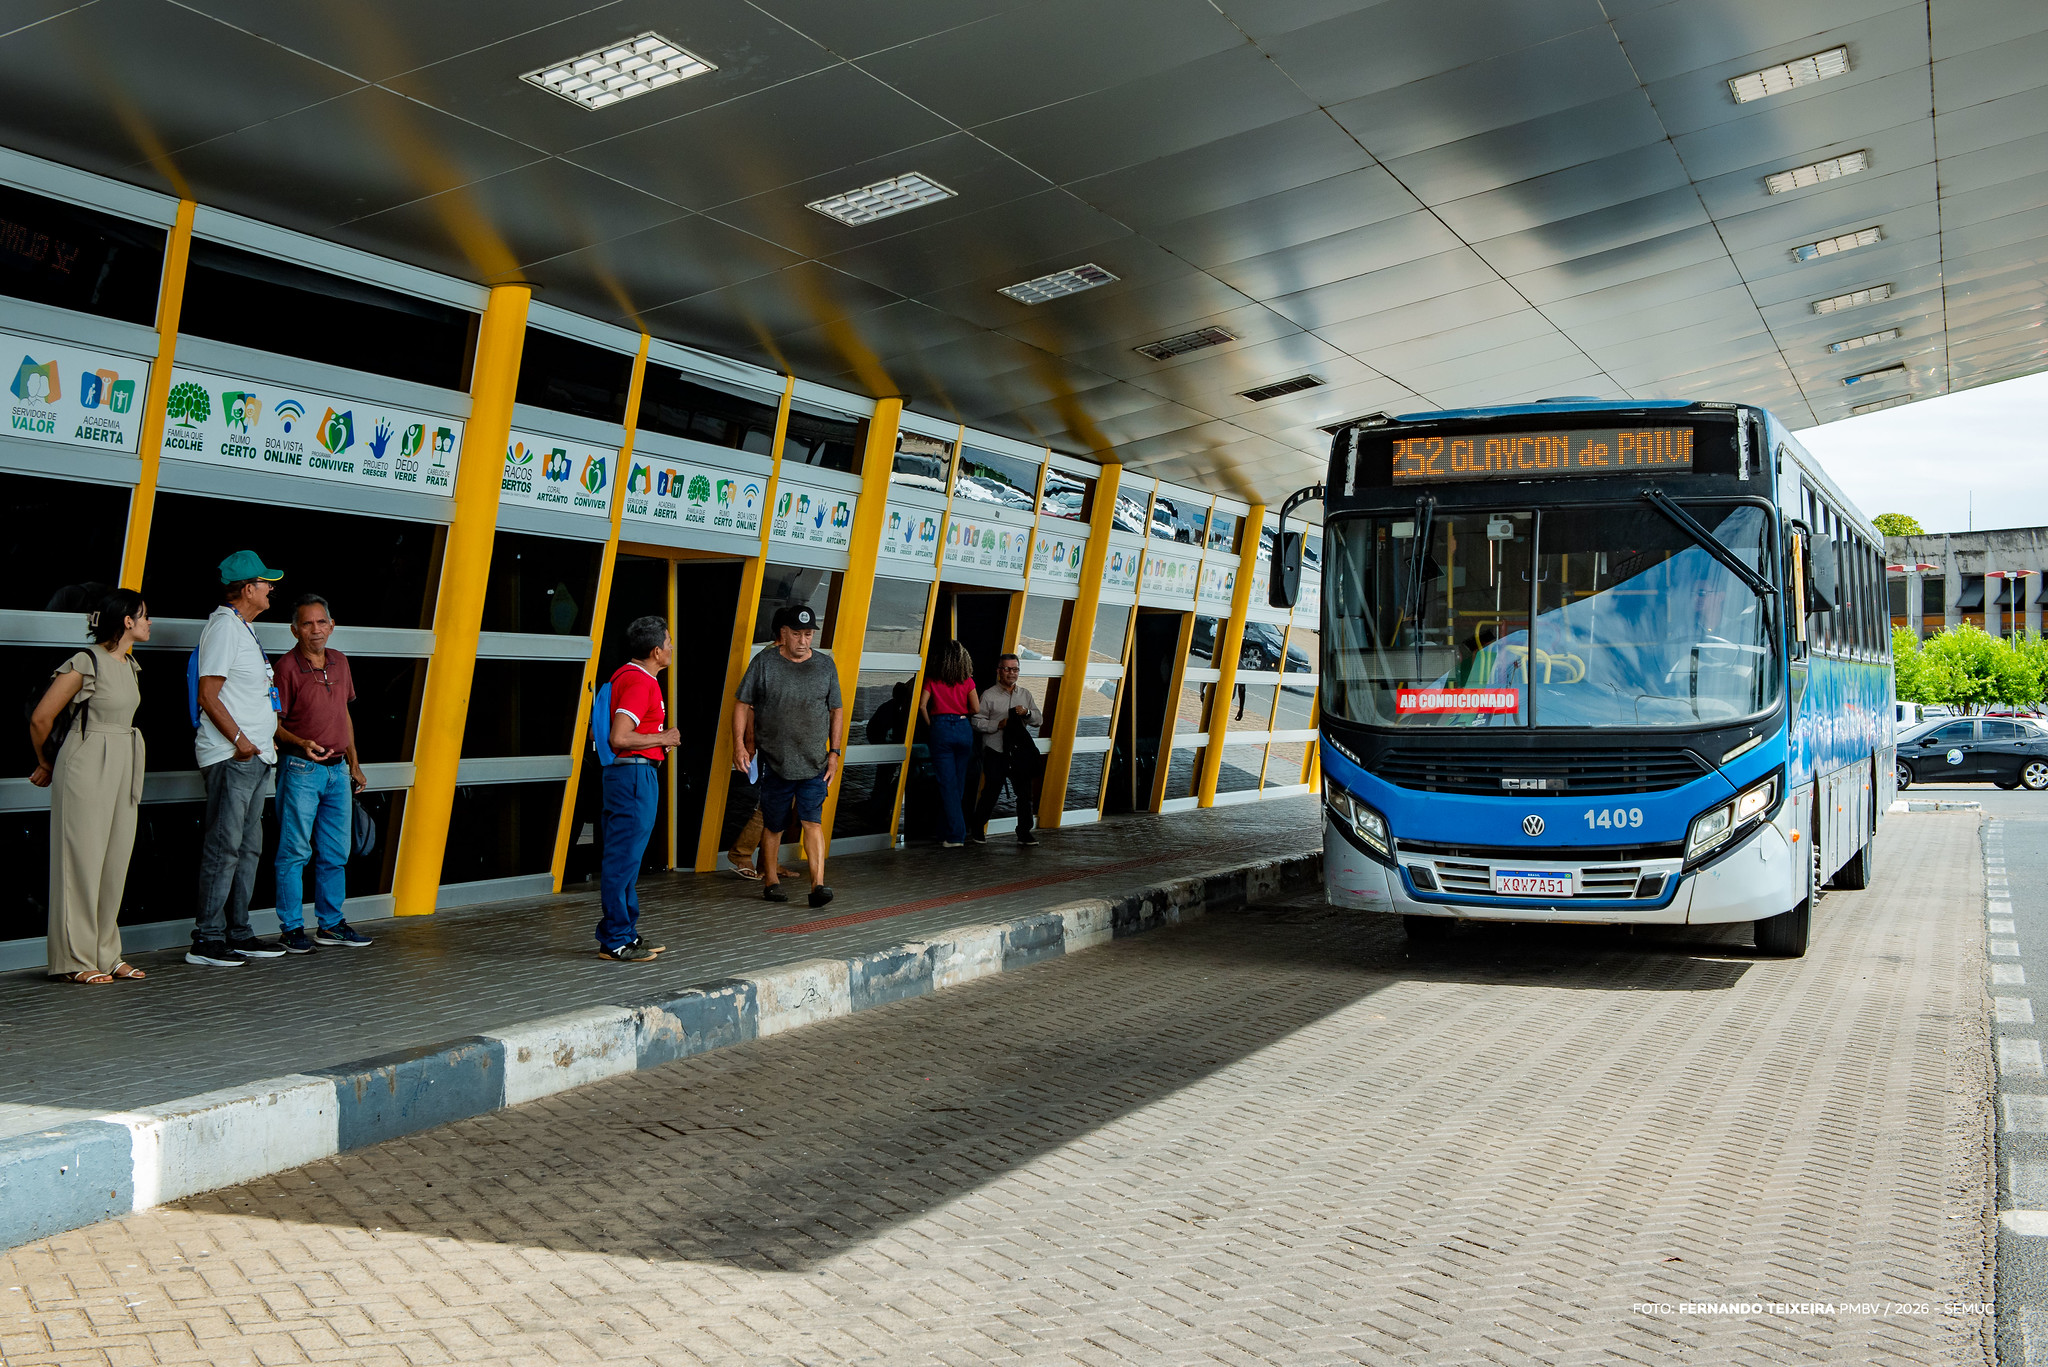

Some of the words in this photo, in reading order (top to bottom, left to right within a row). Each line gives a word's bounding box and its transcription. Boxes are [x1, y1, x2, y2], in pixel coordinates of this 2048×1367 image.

[12, 407, 46, 420] SERVIDOR
[47, 411, 57, 421] DE
[11, 415, 55, 434] VALOR
[82, 415, 120, 429] ACADEMIA
[74, 425, 123, 444] ABERTA
[167, 428, 190, 439] FAMÍLIA
[191, 431, 204, 440] QUE
[230, 433, 251, 445] RUMO
[164, 437, 203, 452] ACOLHE
[220, 443, 257, 459] CERTO
[265, 437, 281, 449] BOA
[283, 440, 304, 452] VISTA
[264, 449, 303, 466] ONLINE
[1393, 437, 1444, 476] 252
[1451, 436, 1569, 472] GLAYCON
[1579, 440, 1609, 467] de
[308, 456, 354, 473] CONVIVER
[363, 459, 389, 471] PROJETO
[395, 458, 419, 473] DEDO
[362, 467, 387, 478] CRESCER
[394, 471, 417, 483] VERDE
[504, 465, 532, 481] RACOS
[426, 475, 448, 487] PRATA
[501, 478, 532, 494] BERTOS
[536, 492, 568, 504] ARTCANTO
[573, 496, 606, 510] CONVIVER
[626, 503, 648, 515] VALOR
[653, 508, 677, 520] ABERTA
[685, 514, 705, 524] ACOLHE
[713, 517, 732, 527] CERTO
[736, 519, 757, 531] ONLINE
[1400, 694, 1417, 708] AR
[1419, 693, 1515, 708] CONDICIONADO
[1583, 808, 1644, 829] 1409
